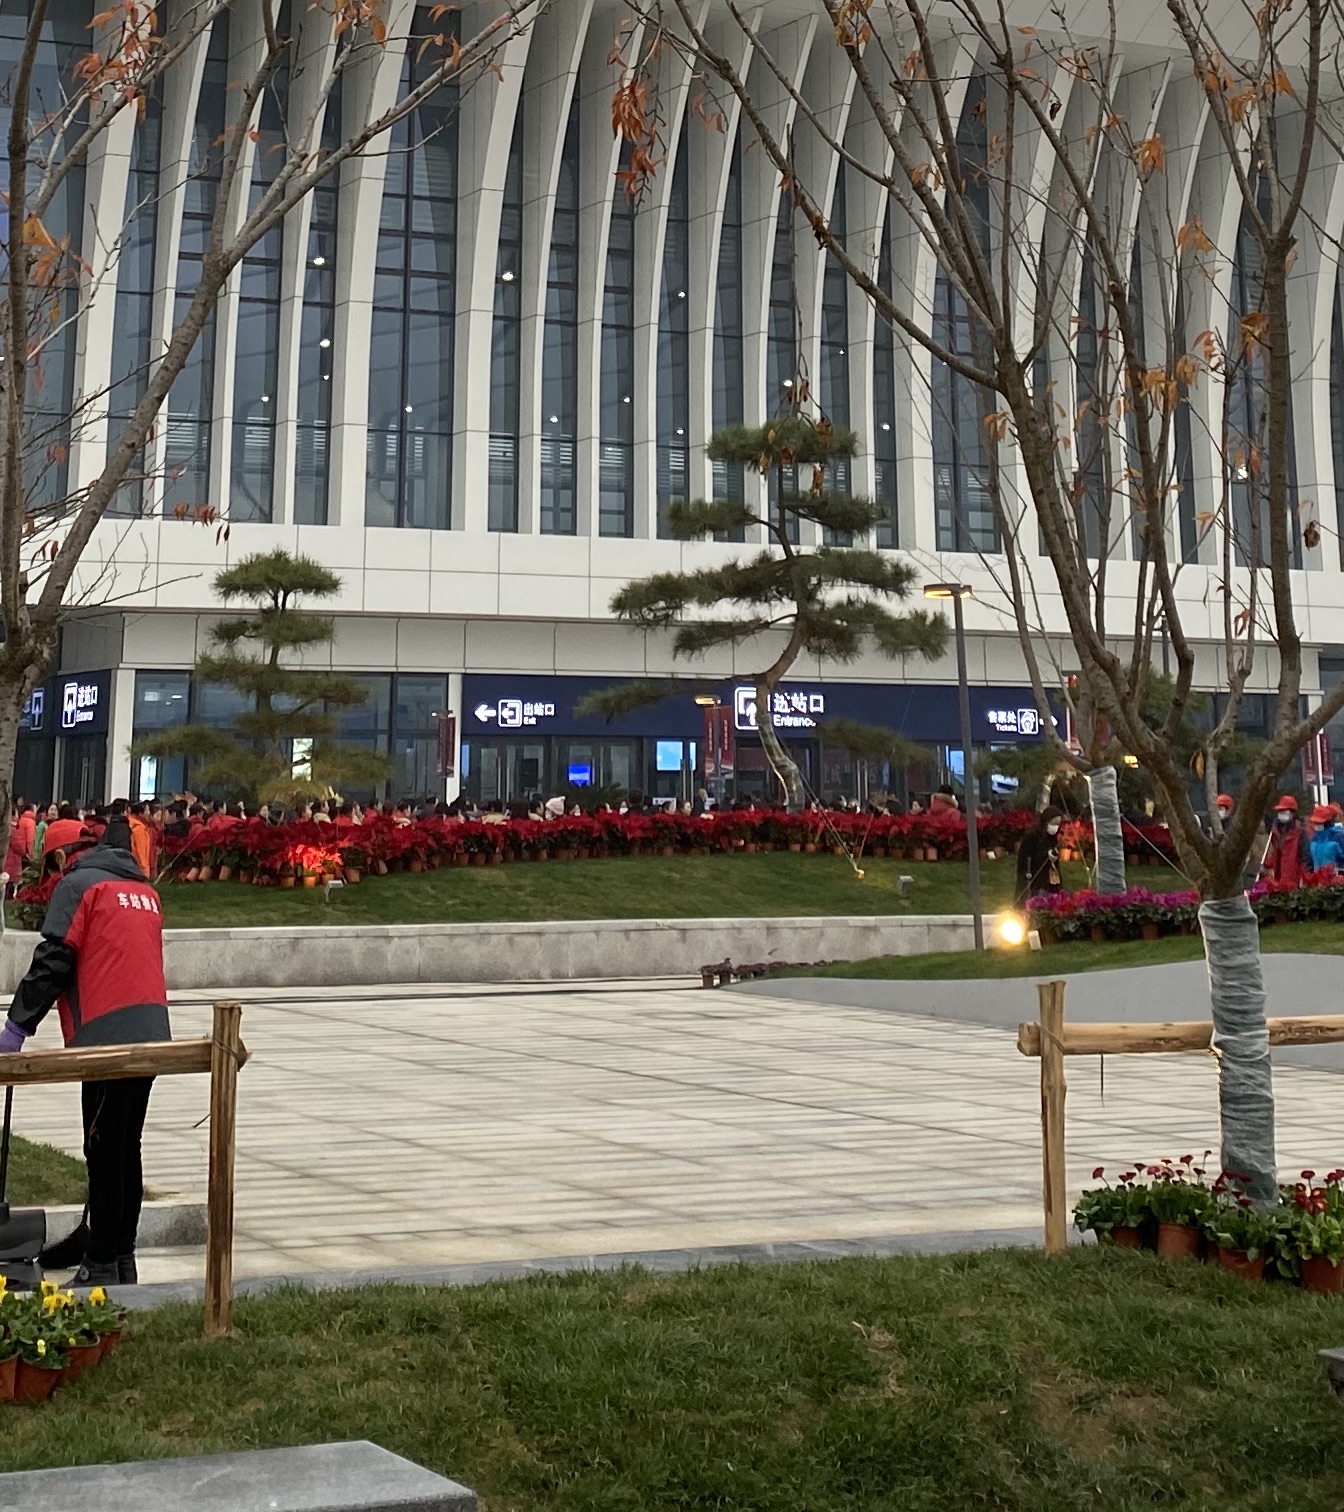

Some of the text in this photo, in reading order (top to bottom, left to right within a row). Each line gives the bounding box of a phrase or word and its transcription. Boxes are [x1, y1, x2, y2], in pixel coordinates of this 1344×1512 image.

[523, 702, 555, 716] 出站口
[773, 691, 824, 714] 进站口
[987, 710, 1017, 724] 售票处
